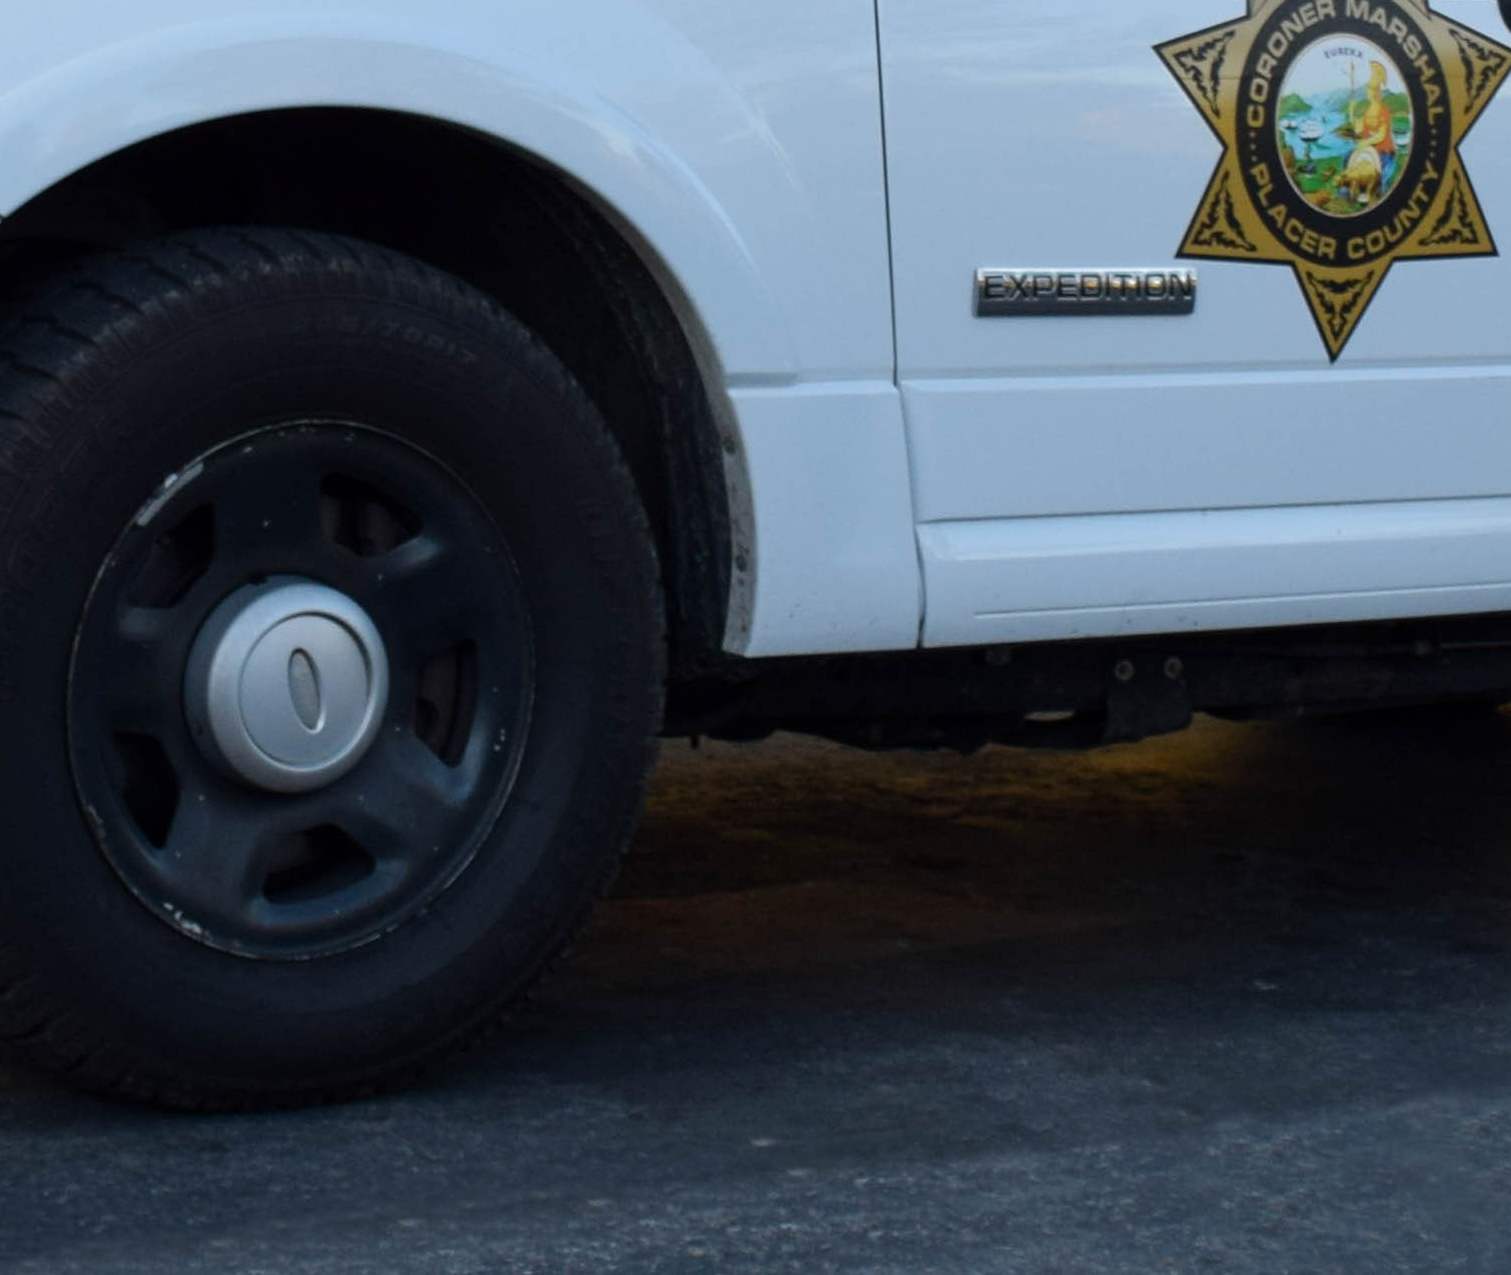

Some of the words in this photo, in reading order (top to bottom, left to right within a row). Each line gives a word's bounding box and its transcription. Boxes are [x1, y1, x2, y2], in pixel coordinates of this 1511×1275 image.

[1248, 161, 1337, 260] PLACER
[1347, 159, 1442, 260] COUNTY
[984, 271, 1193, 301] EXPEDITION
